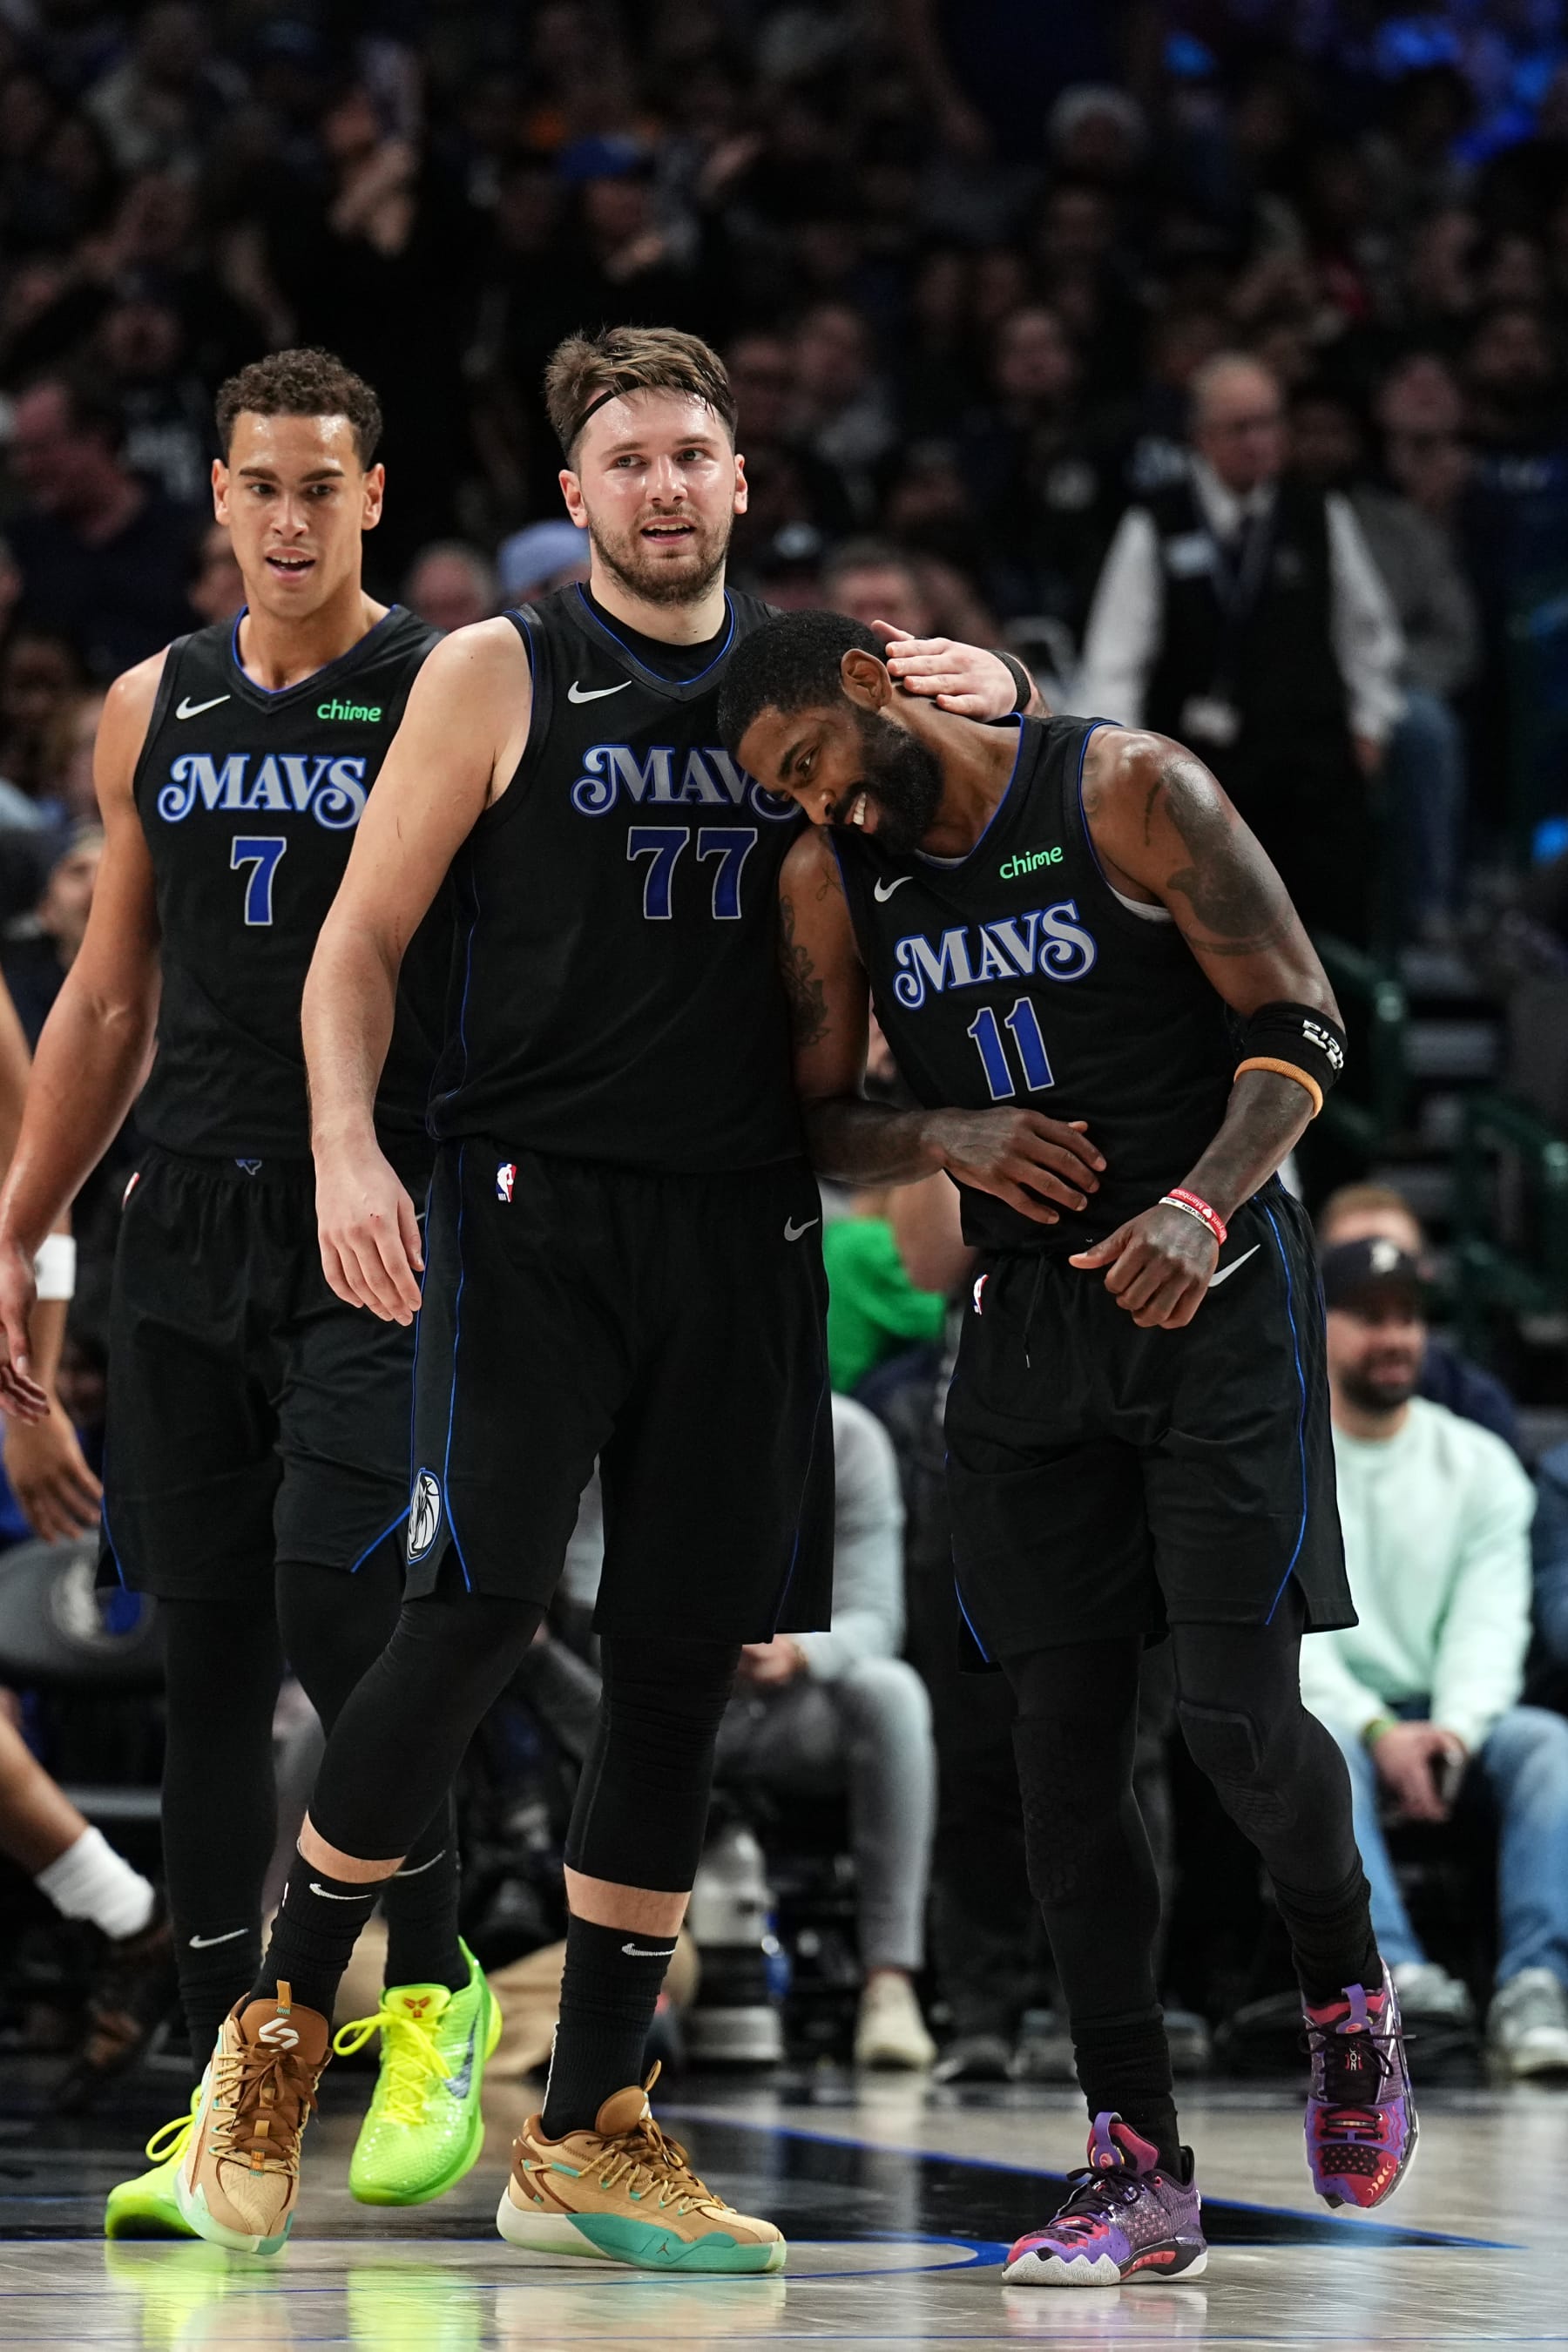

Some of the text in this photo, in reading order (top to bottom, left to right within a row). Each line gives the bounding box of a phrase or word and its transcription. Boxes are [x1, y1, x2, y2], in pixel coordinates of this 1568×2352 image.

[316, 699, 382, 721] chime
[158, 754, 368, 829] MAVS
[230, 835, 287, 925] 7
[626, 826, 758, 920] 77
[1000, 846, 1064, 879] chime
[893, 899, 1098, 1010] MAVS
[967, 997, 1055, 1101] 11
